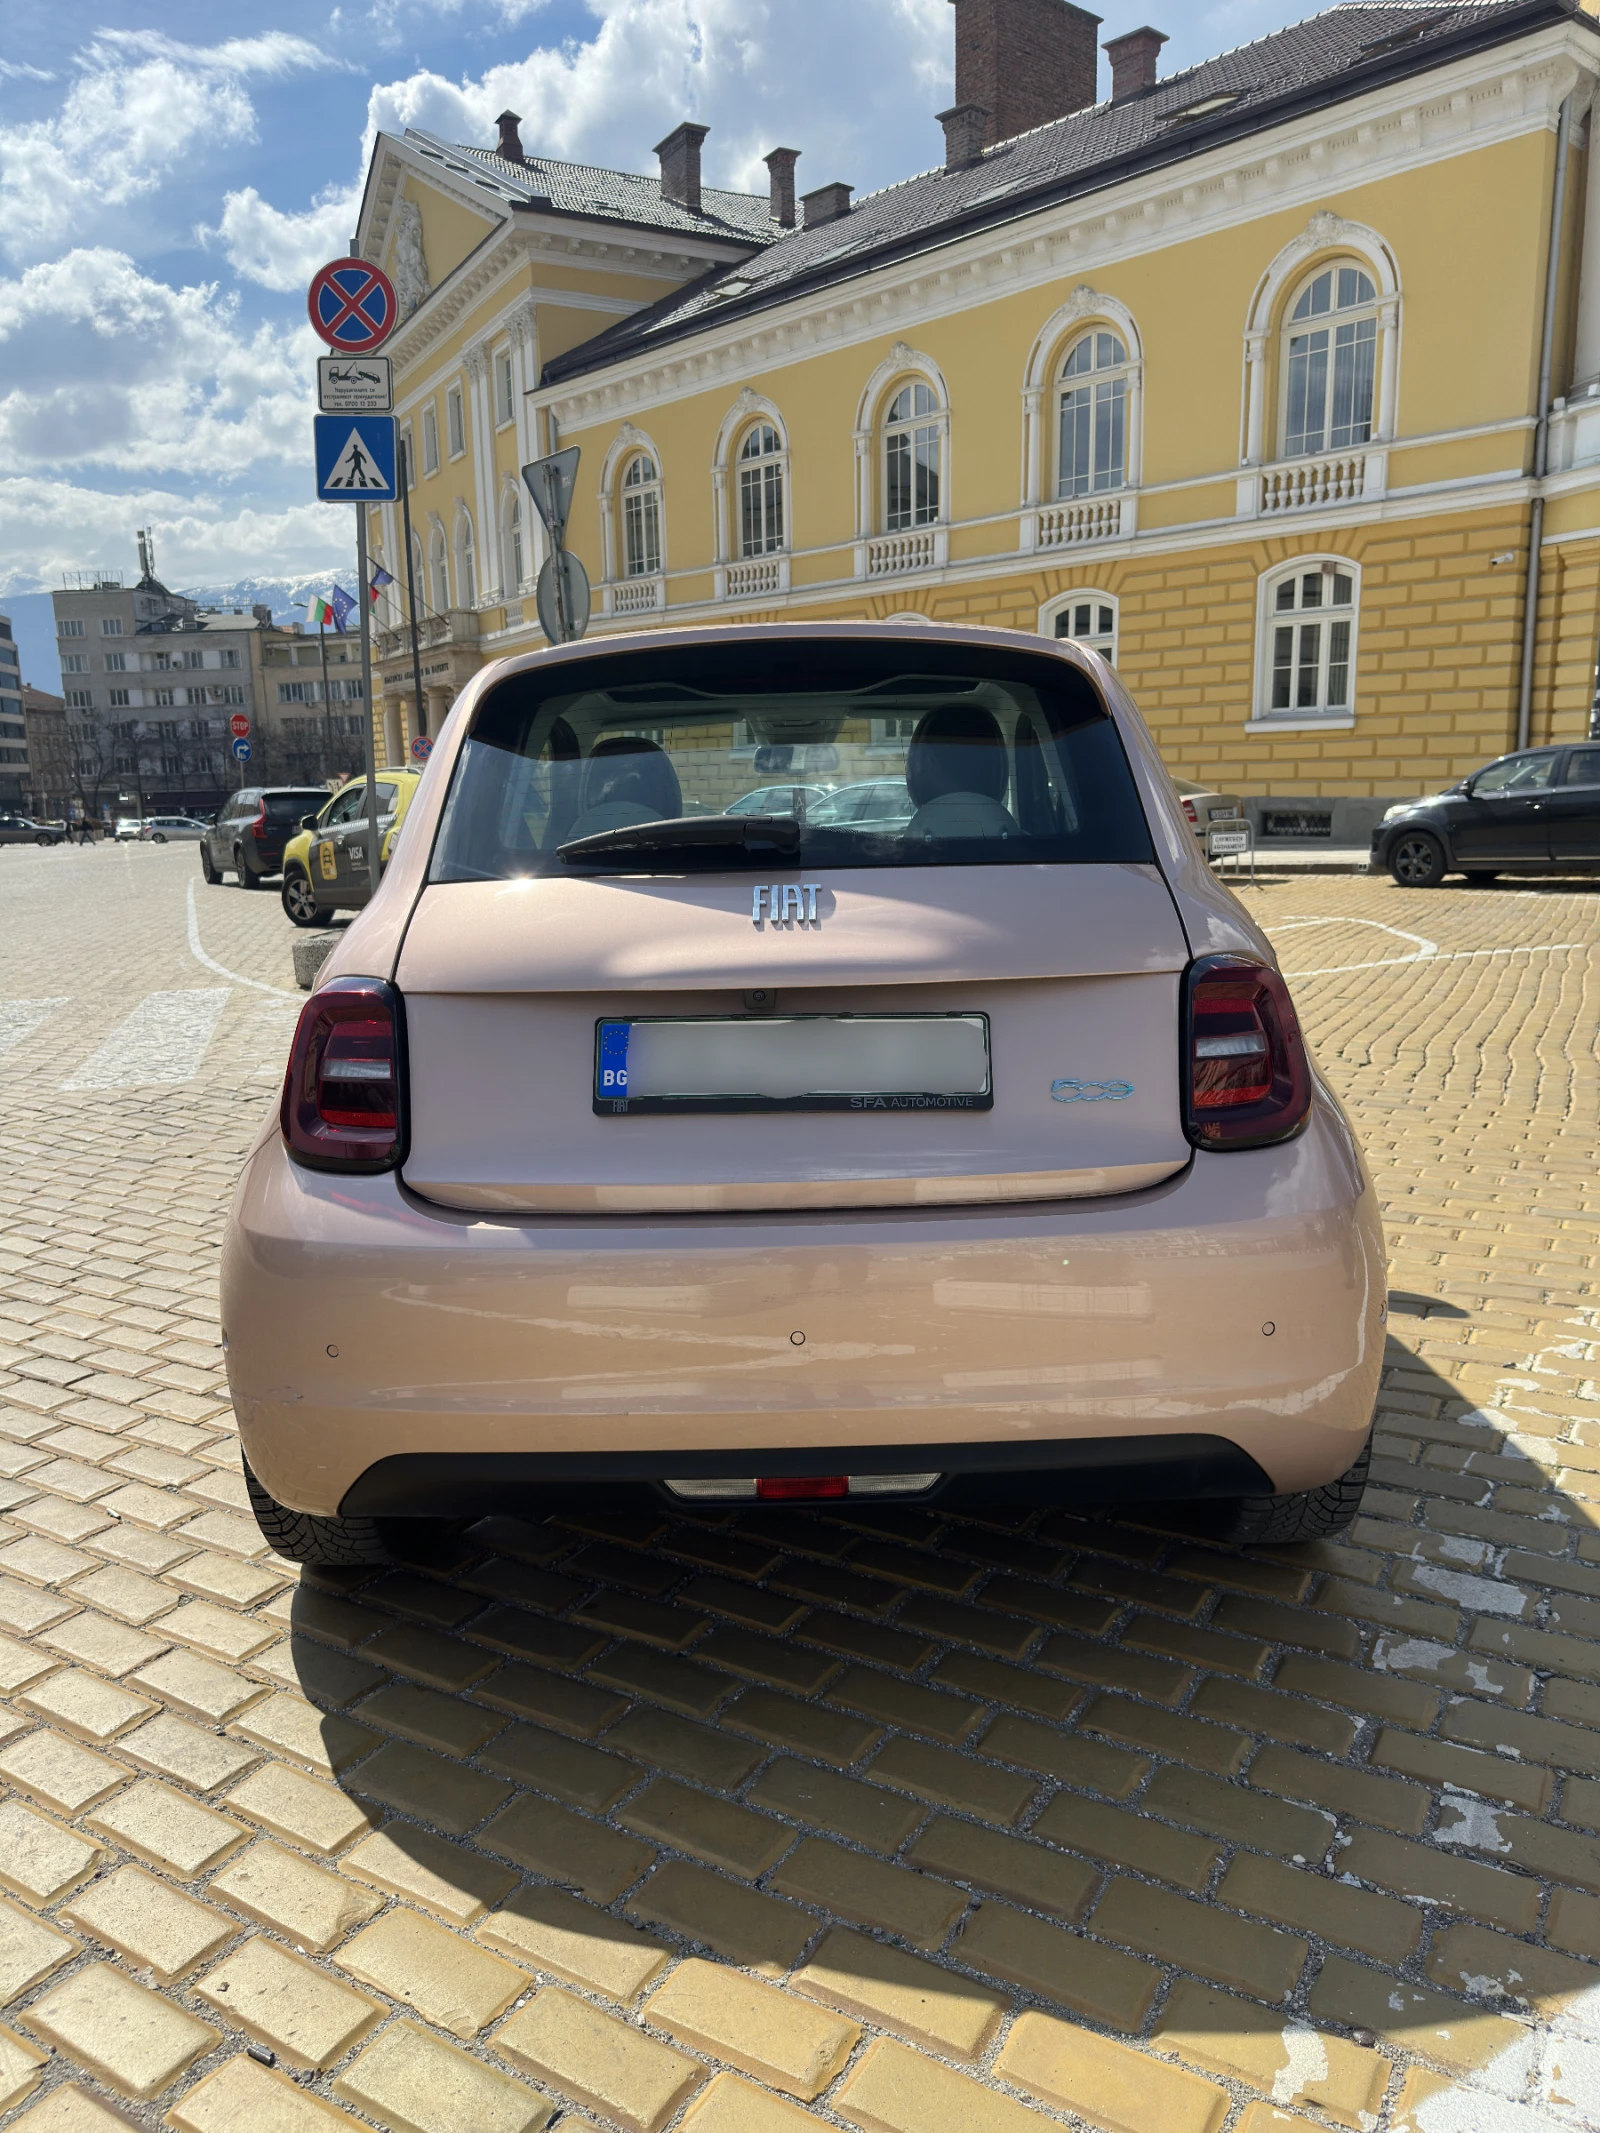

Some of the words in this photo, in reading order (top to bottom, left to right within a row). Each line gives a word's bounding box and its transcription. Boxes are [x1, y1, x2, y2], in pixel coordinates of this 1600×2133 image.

[232, 721, 248, 730] STOP
[348, 846, 364, 860] VISA
[752, 884, 822, 922] FIAT
[603, 1069, 628, 1087] BG
[612, 1100, 629, 1113] FIAT
[850, 1097, 887, 1108] SFA
[890, 1097, 974, 1108] AUTOMOTIVE
